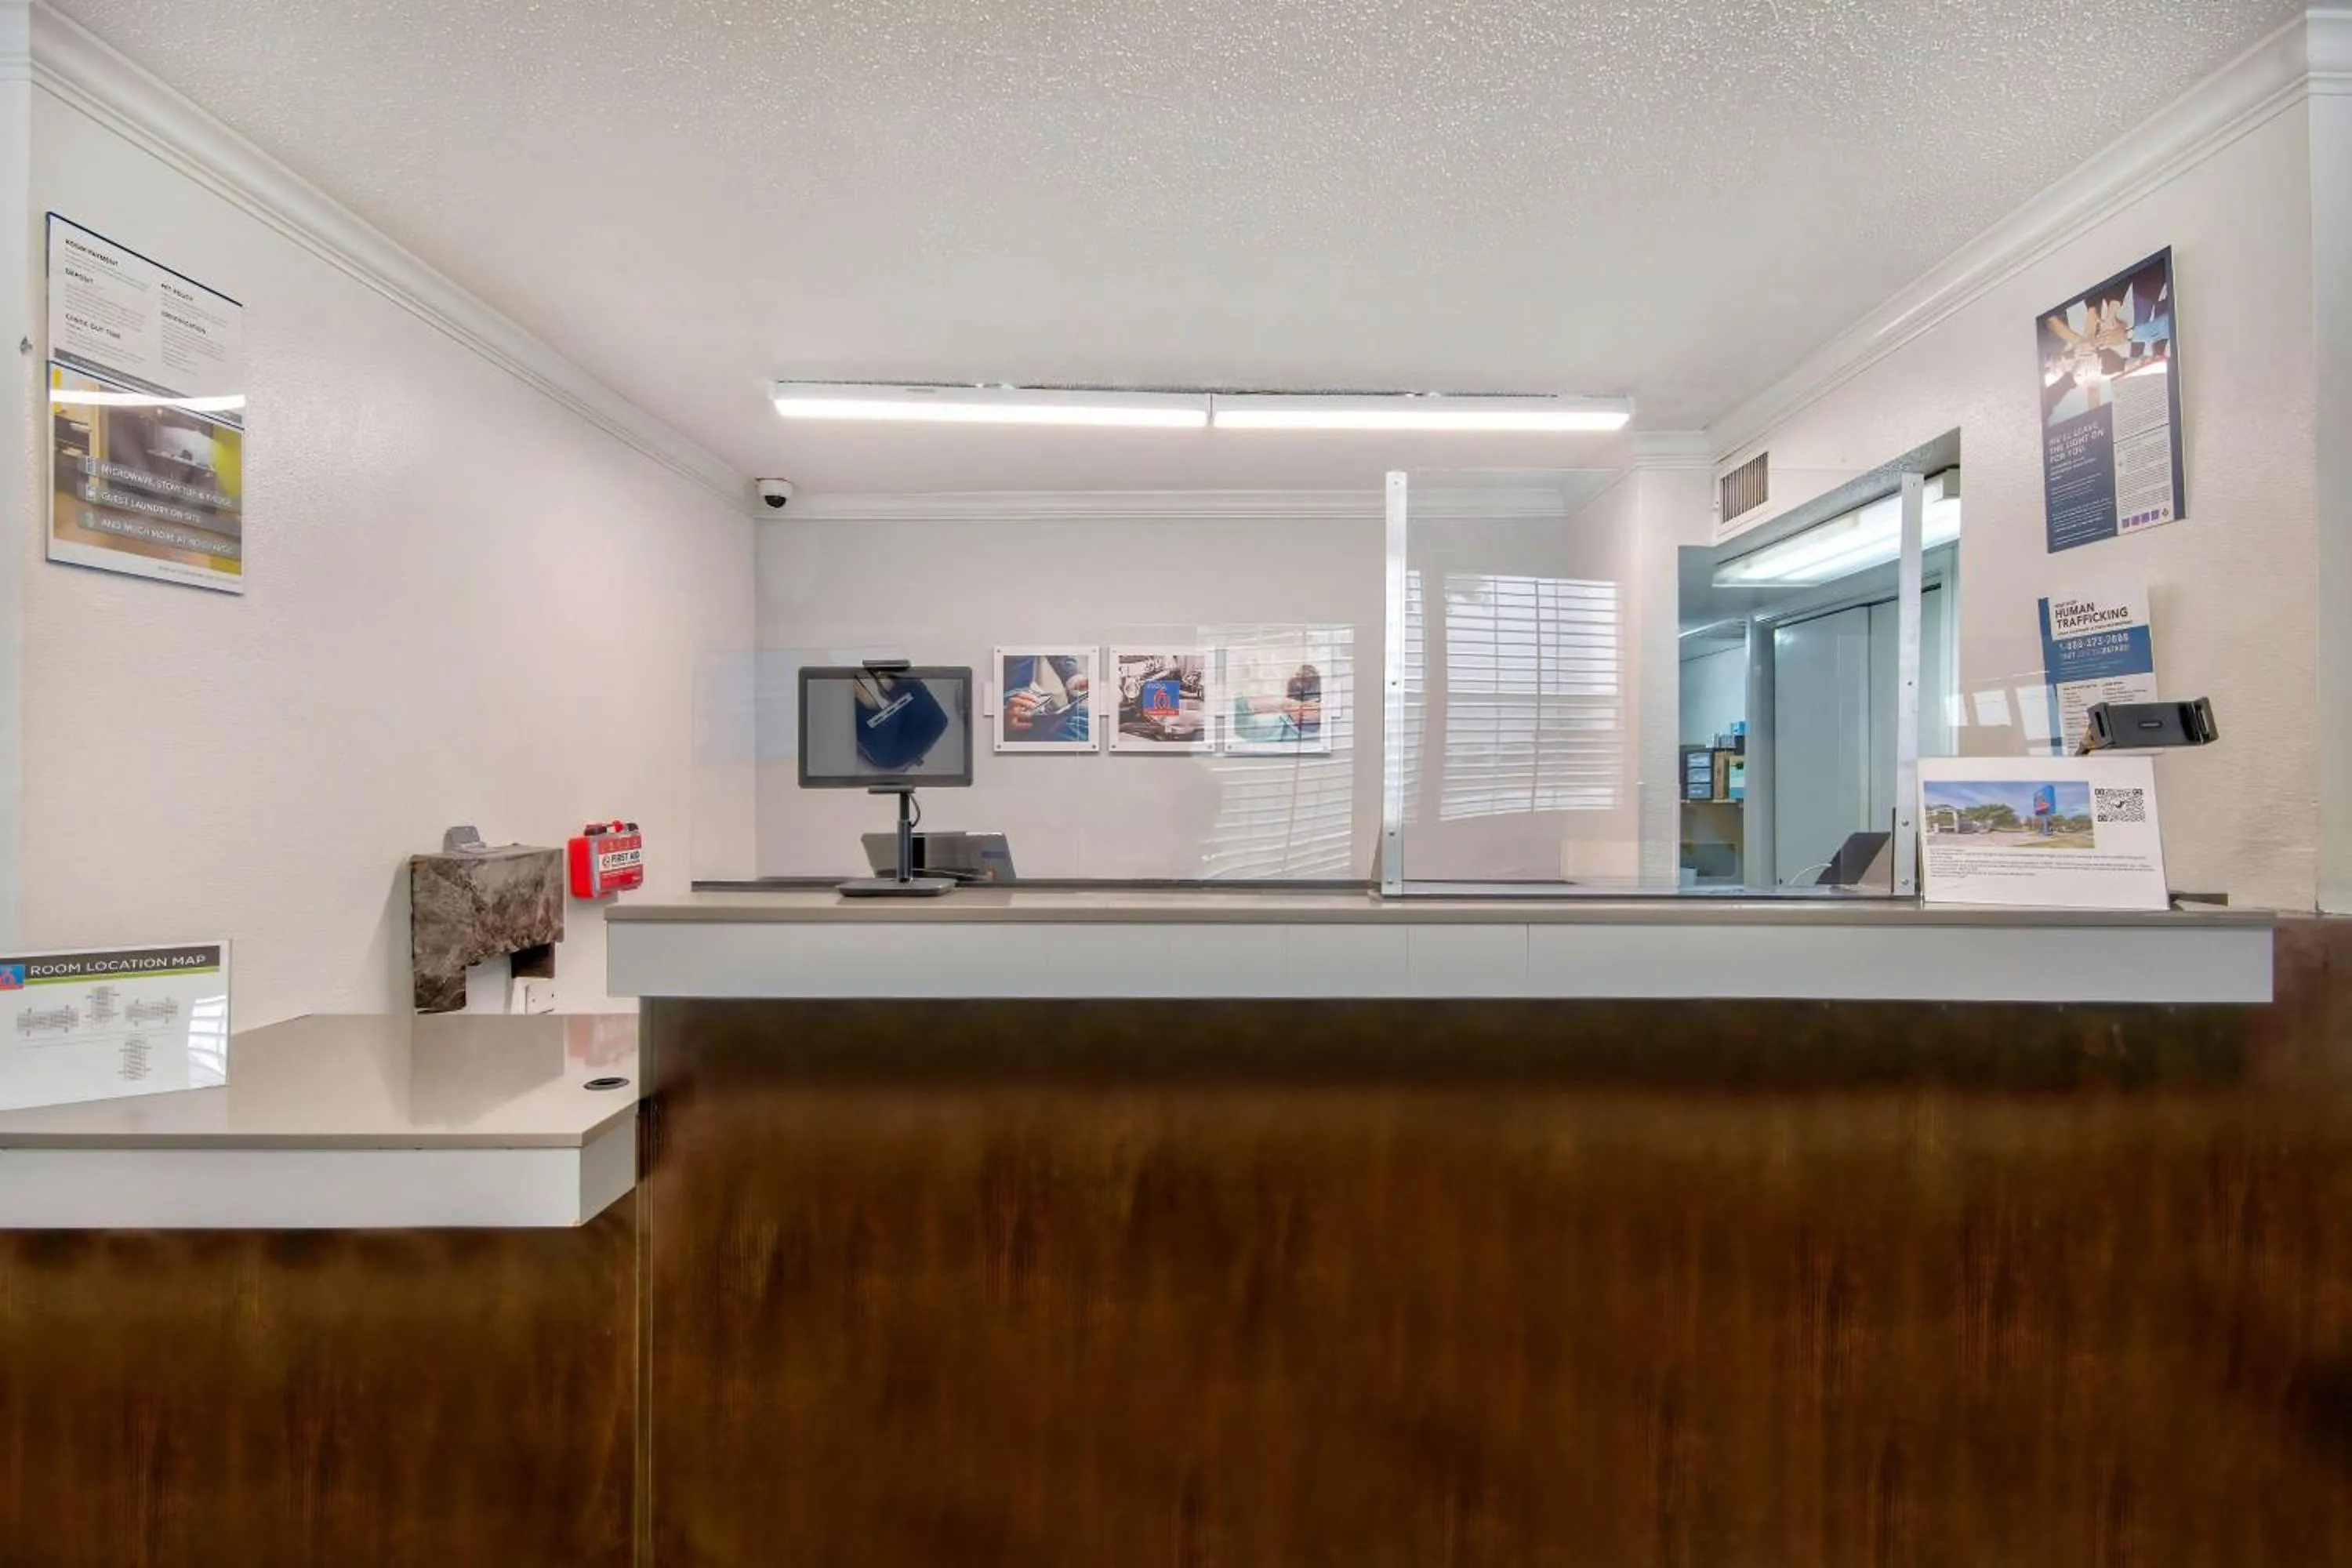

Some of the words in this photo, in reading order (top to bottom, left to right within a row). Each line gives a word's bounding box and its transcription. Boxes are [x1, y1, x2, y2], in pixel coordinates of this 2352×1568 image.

[101, 517, 122, 530] AND
[2055, 601, 2095, 619] HUMAN
[2057, 605, 2129, 629] TRAFFICKING
[611, 852, 628, 862] FIRST
[630, 851, 641, 860] AID
[30, 962, 81, 976] ROOM
[85, 956, 168, 972] LOCATION
[171, 954, 207, 967] MAP
